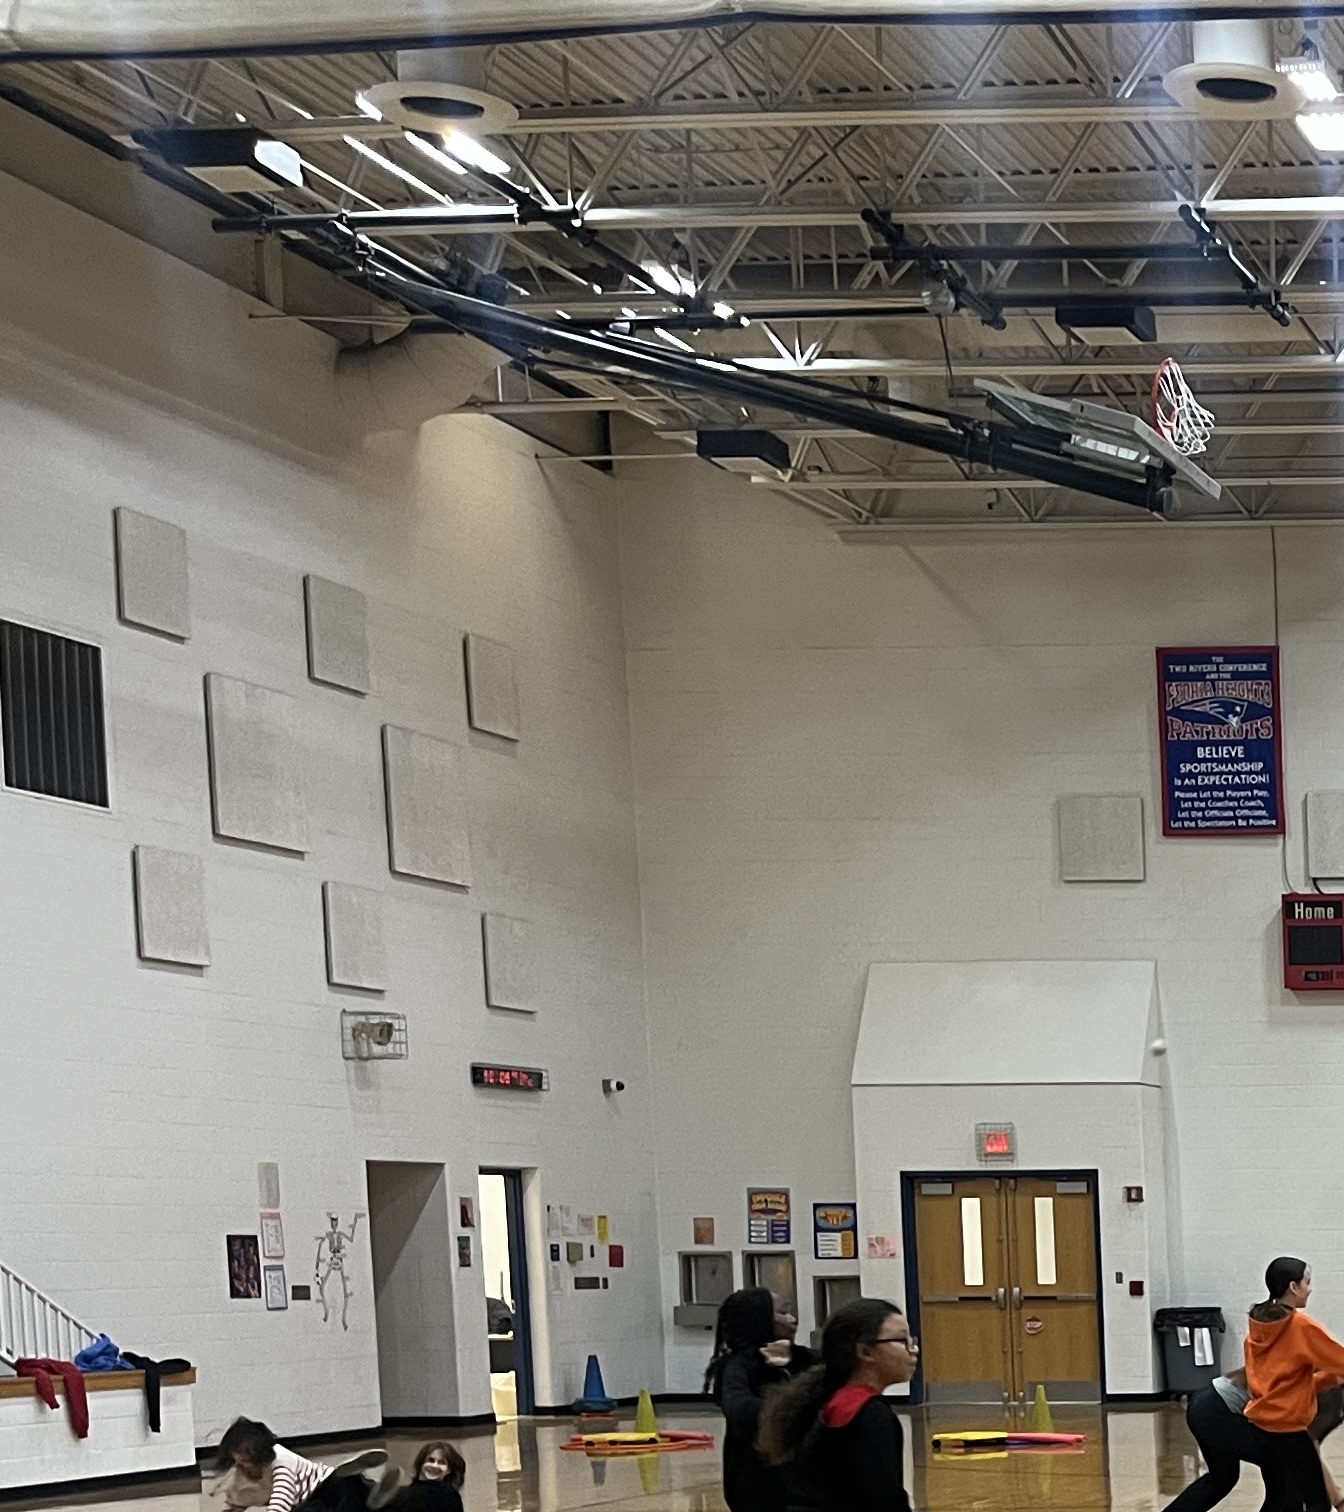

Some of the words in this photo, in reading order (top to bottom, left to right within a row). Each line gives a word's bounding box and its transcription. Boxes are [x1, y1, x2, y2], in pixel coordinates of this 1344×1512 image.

[1167, 715, 1274, 740] PATRIOTS
[1197, 746, 1245, 758] BELIEVE
[1180, 762, 1264, 773] SPORTSMANSHIP
[1183, 777, 1196, 786] An
[1197, 774, 1270, 785] EXPECTATION!
[1294, 903, 1335, 920] Home
